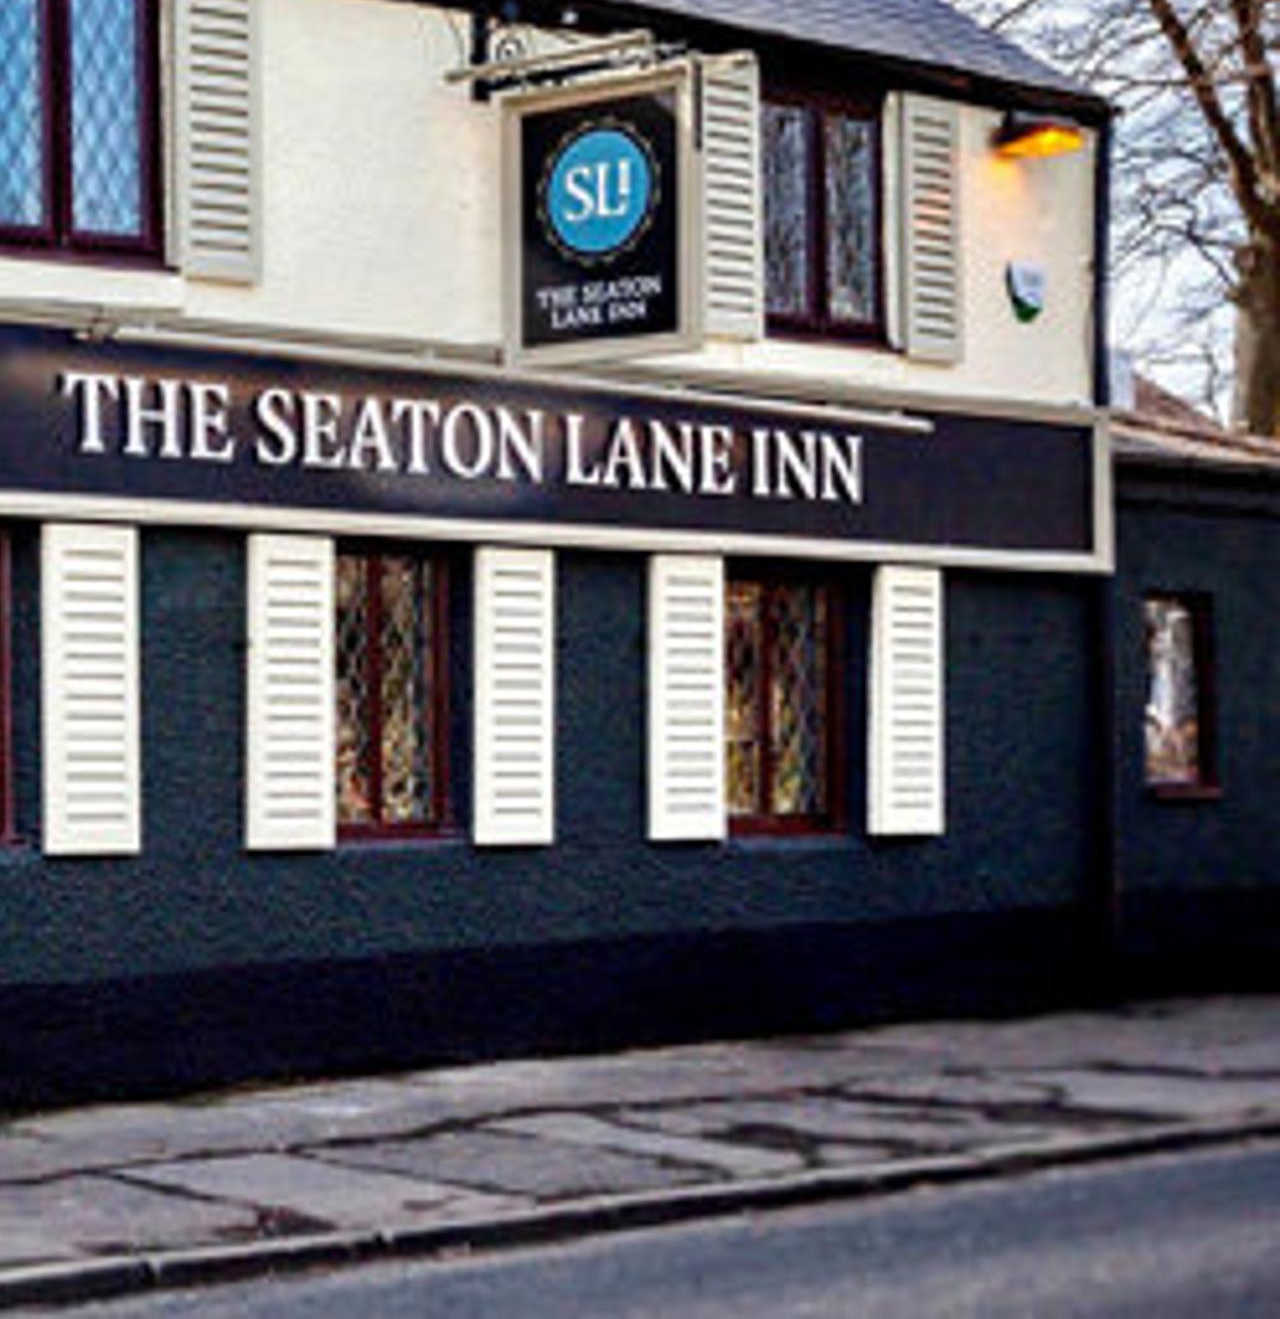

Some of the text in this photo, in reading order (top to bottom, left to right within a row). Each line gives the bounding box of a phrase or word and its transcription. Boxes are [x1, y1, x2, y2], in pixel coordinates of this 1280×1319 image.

[536, 285, 577, 309] THE
[551, 301, 646, 330] LANE INN
[62, 372, 864, 504] THE SEATON LANE INN
